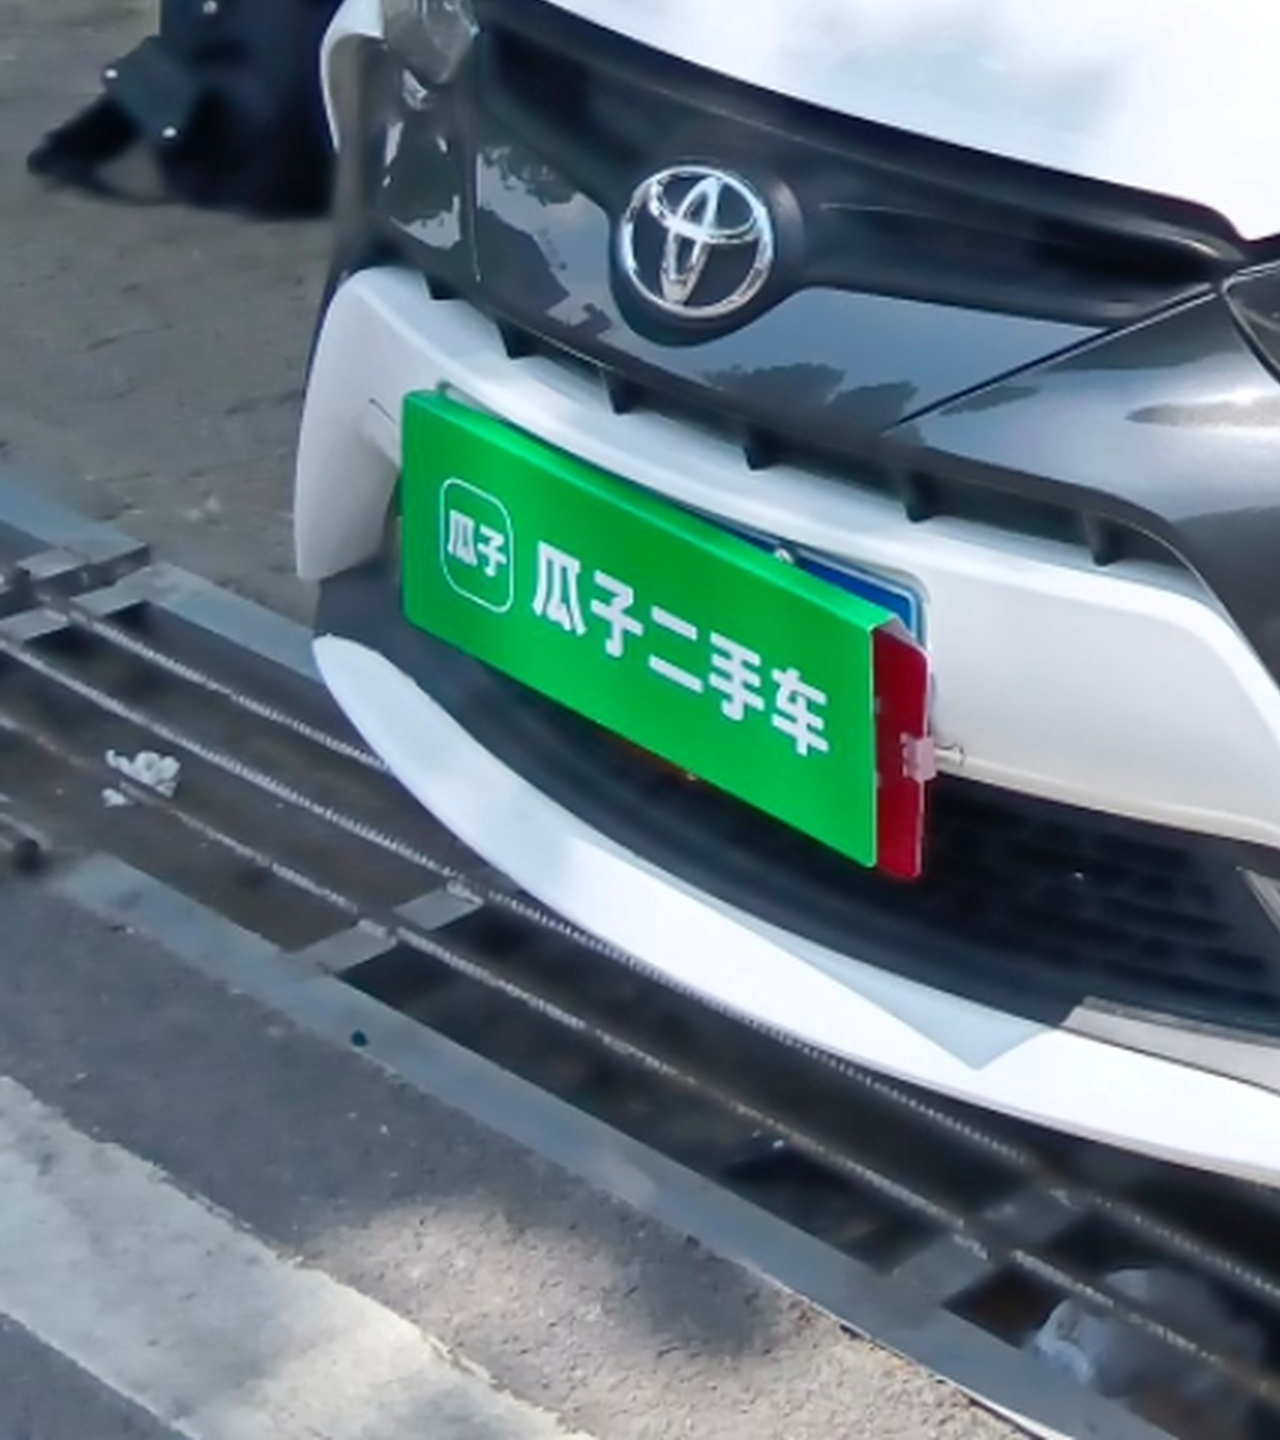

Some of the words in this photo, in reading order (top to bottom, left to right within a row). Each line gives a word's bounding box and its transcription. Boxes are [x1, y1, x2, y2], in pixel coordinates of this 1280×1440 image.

[446, 508, 508, 578] 瓜子
[531, 539, 830, 757] 瓜子二手车
